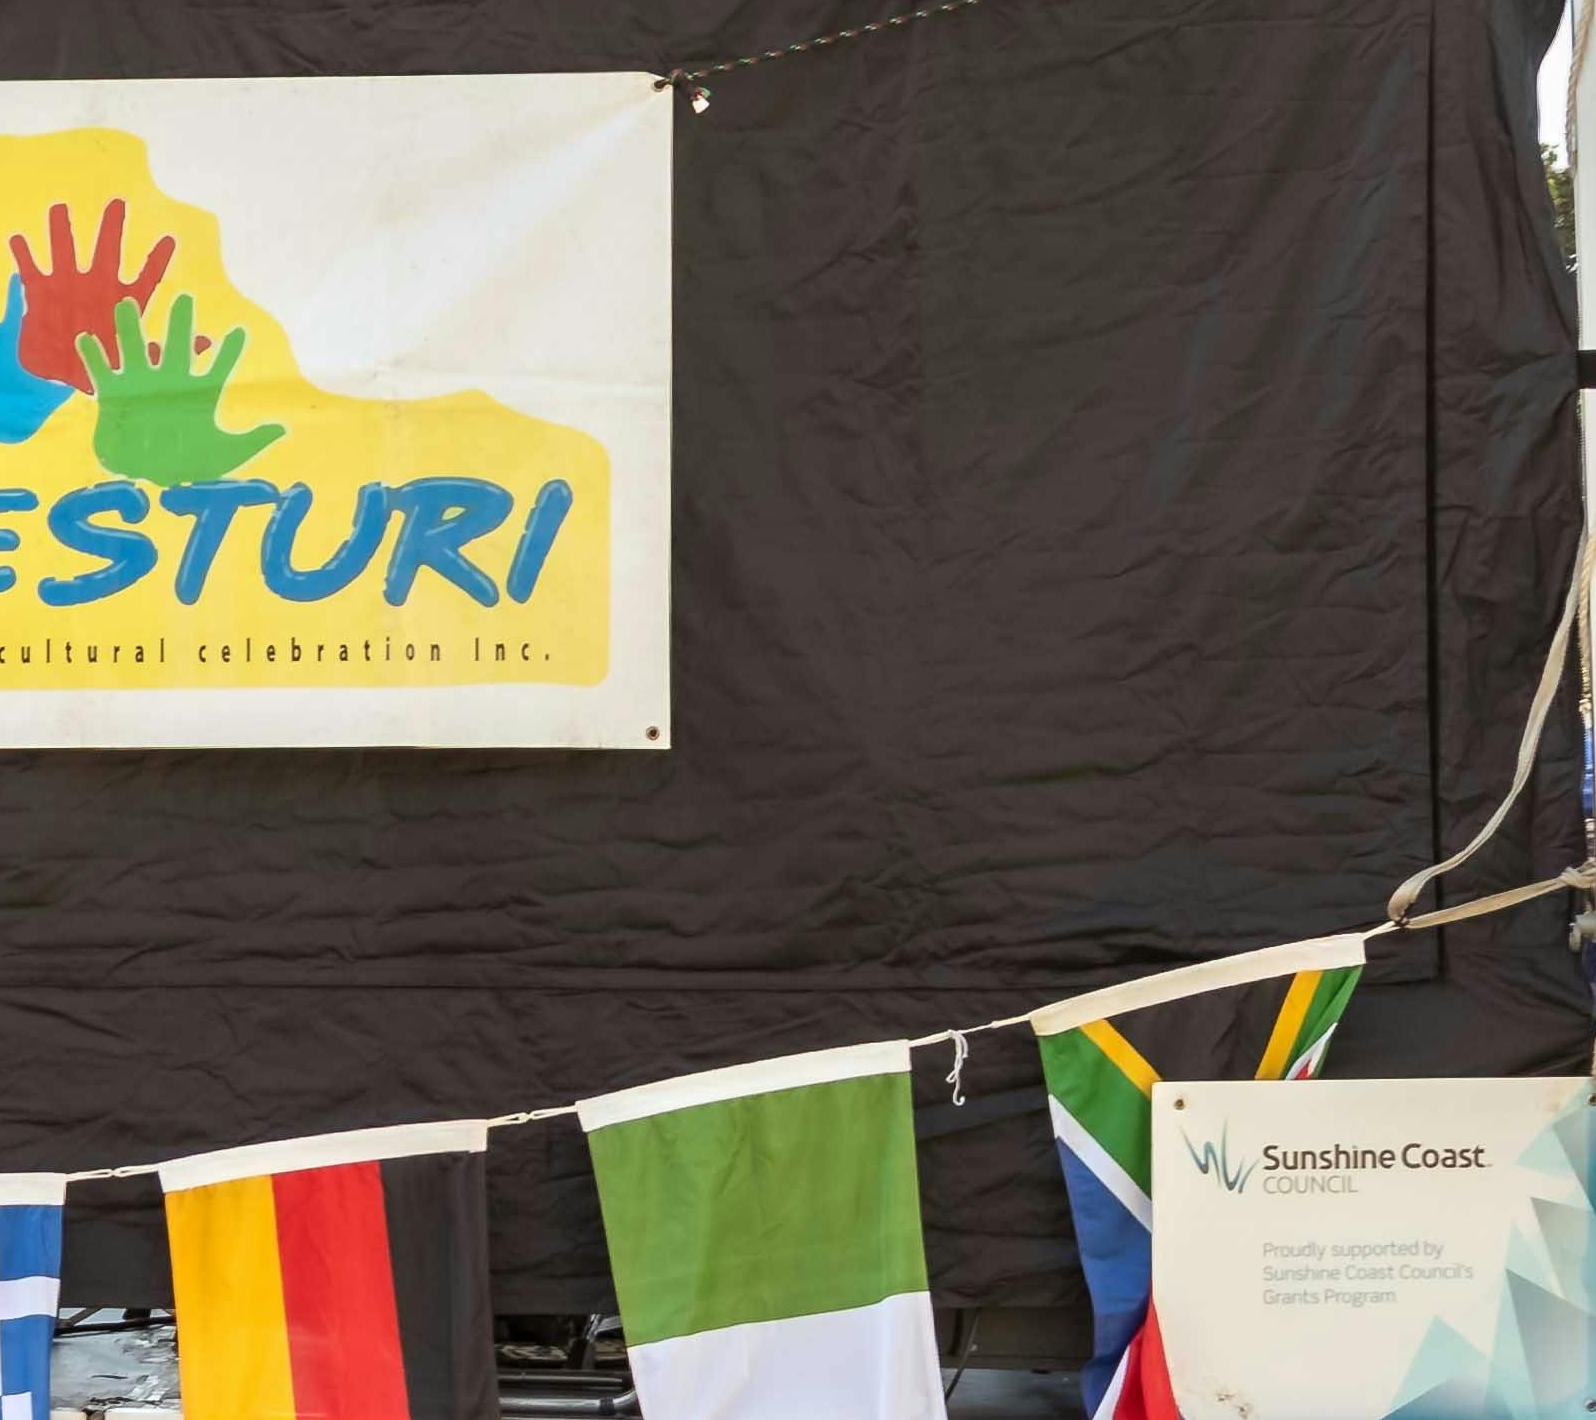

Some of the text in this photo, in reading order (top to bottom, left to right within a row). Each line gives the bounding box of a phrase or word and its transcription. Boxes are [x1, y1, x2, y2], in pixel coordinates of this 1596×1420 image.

[197, 637, 442, 664] celebration
[474, 638, 552, 662] Inc.
[1261, 1143, 1487, 1171] Sunshine Coast
[1262, 1175, 1359, 1195] COUNCIL
[1262, 1240, 1444, 1262] Proudly supported by
[1262, 1263, 1474, 1281] Sunshine Coast Council's
[1262, 1289, 1396, 1308] Grants Program
